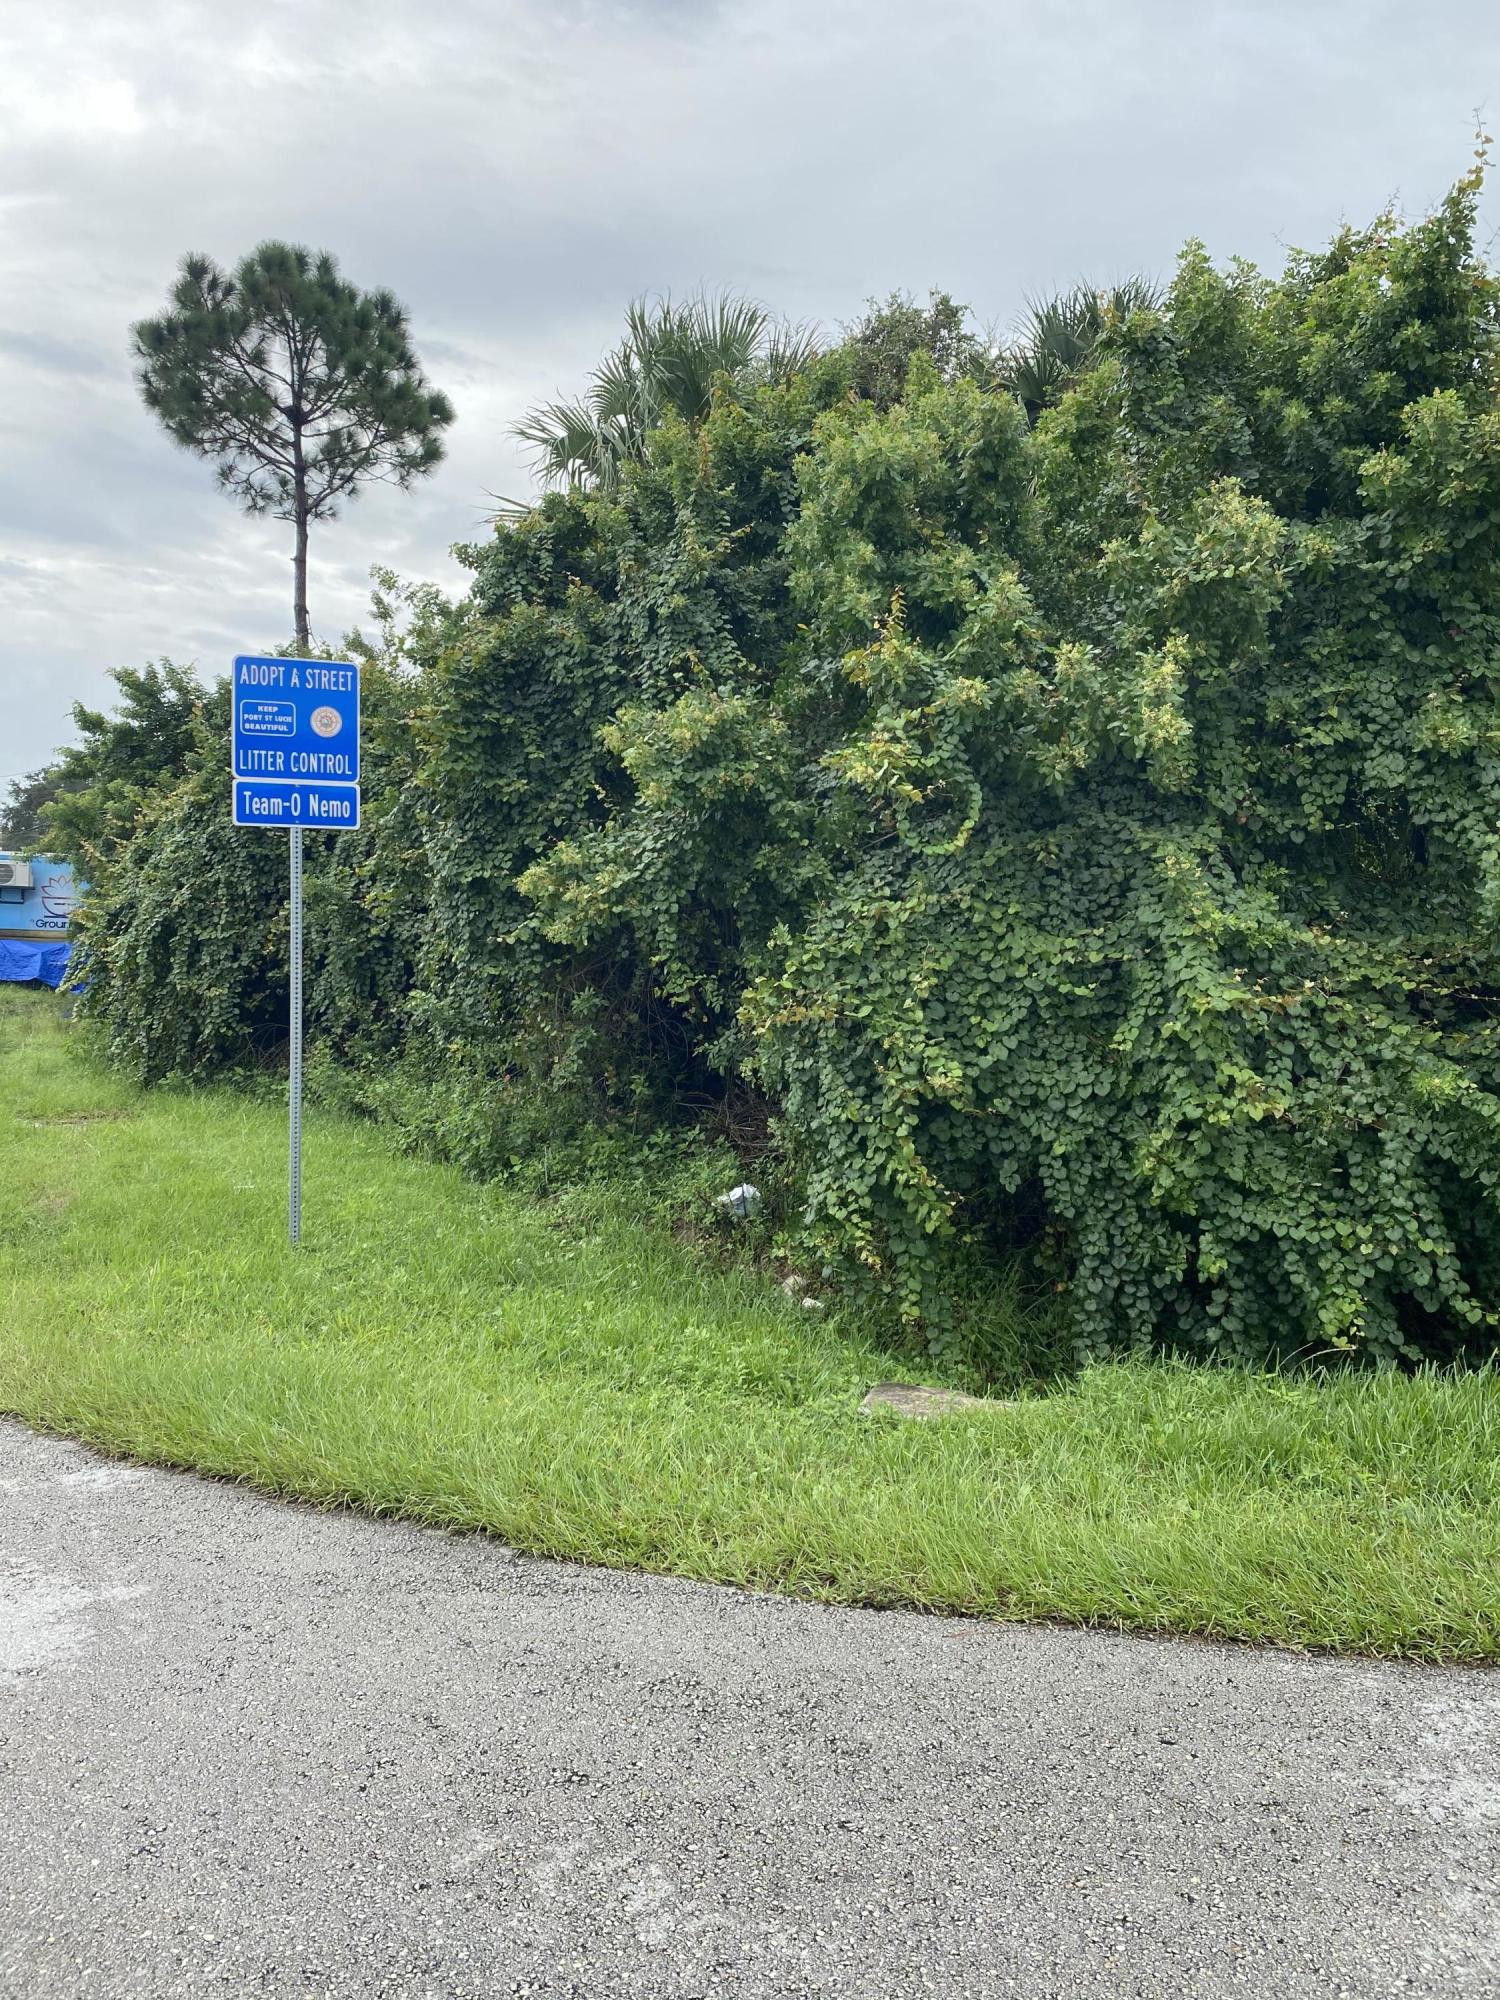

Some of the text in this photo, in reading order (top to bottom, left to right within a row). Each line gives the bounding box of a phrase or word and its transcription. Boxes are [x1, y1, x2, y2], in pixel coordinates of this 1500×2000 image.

[240, 664, 353, 691] ADOPT A STREET
[257, 705, 279, 713] KEEP
[243, 713, 293, 723] PORT ST LUCIE
[244, 723, 289, 732] BEAUTIFUL
[240, 749, 353, 775] LITTER CONTROL
[243, 791, 351, 818] Team-O Nemo
[35, 918, 72, 929] Groun
